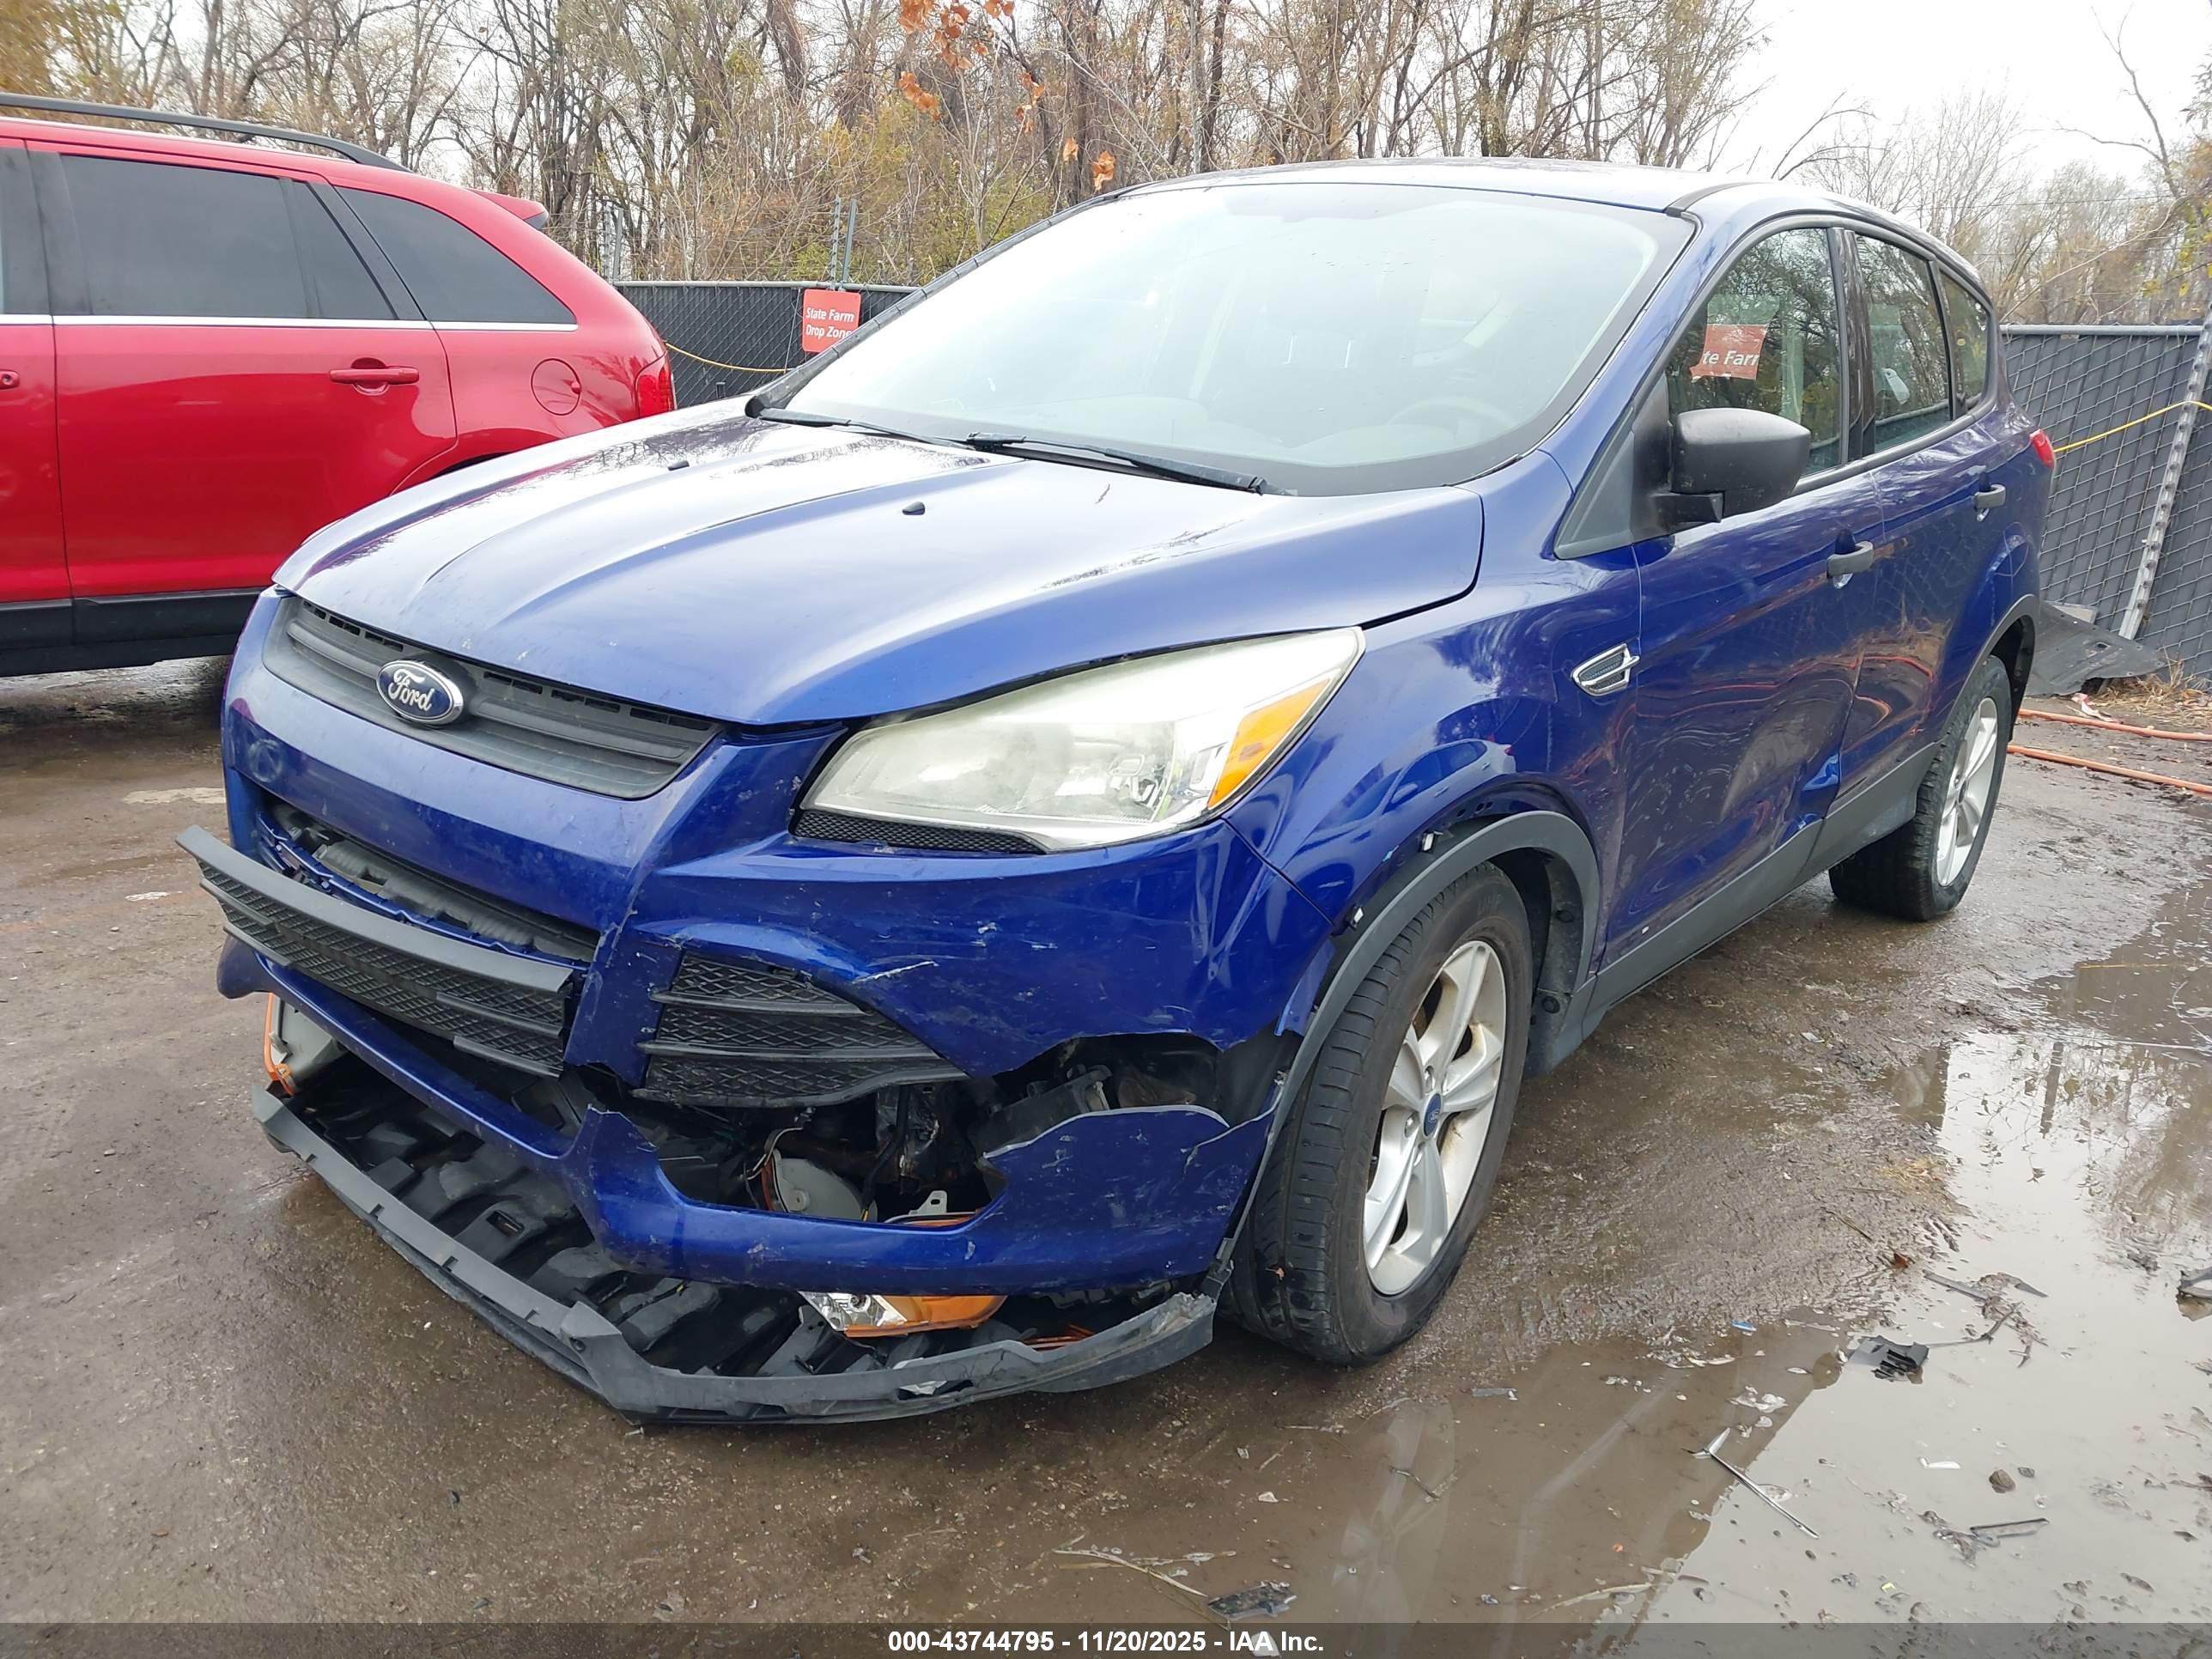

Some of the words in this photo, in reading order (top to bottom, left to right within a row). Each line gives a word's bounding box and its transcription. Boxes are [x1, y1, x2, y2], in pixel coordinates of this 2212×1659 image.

[805, 307, 826, 320] State
[828, 309, 855, 323] Farm
[805, 325, 825, 340] Drop
[387, 668, 435, 711] Ford
